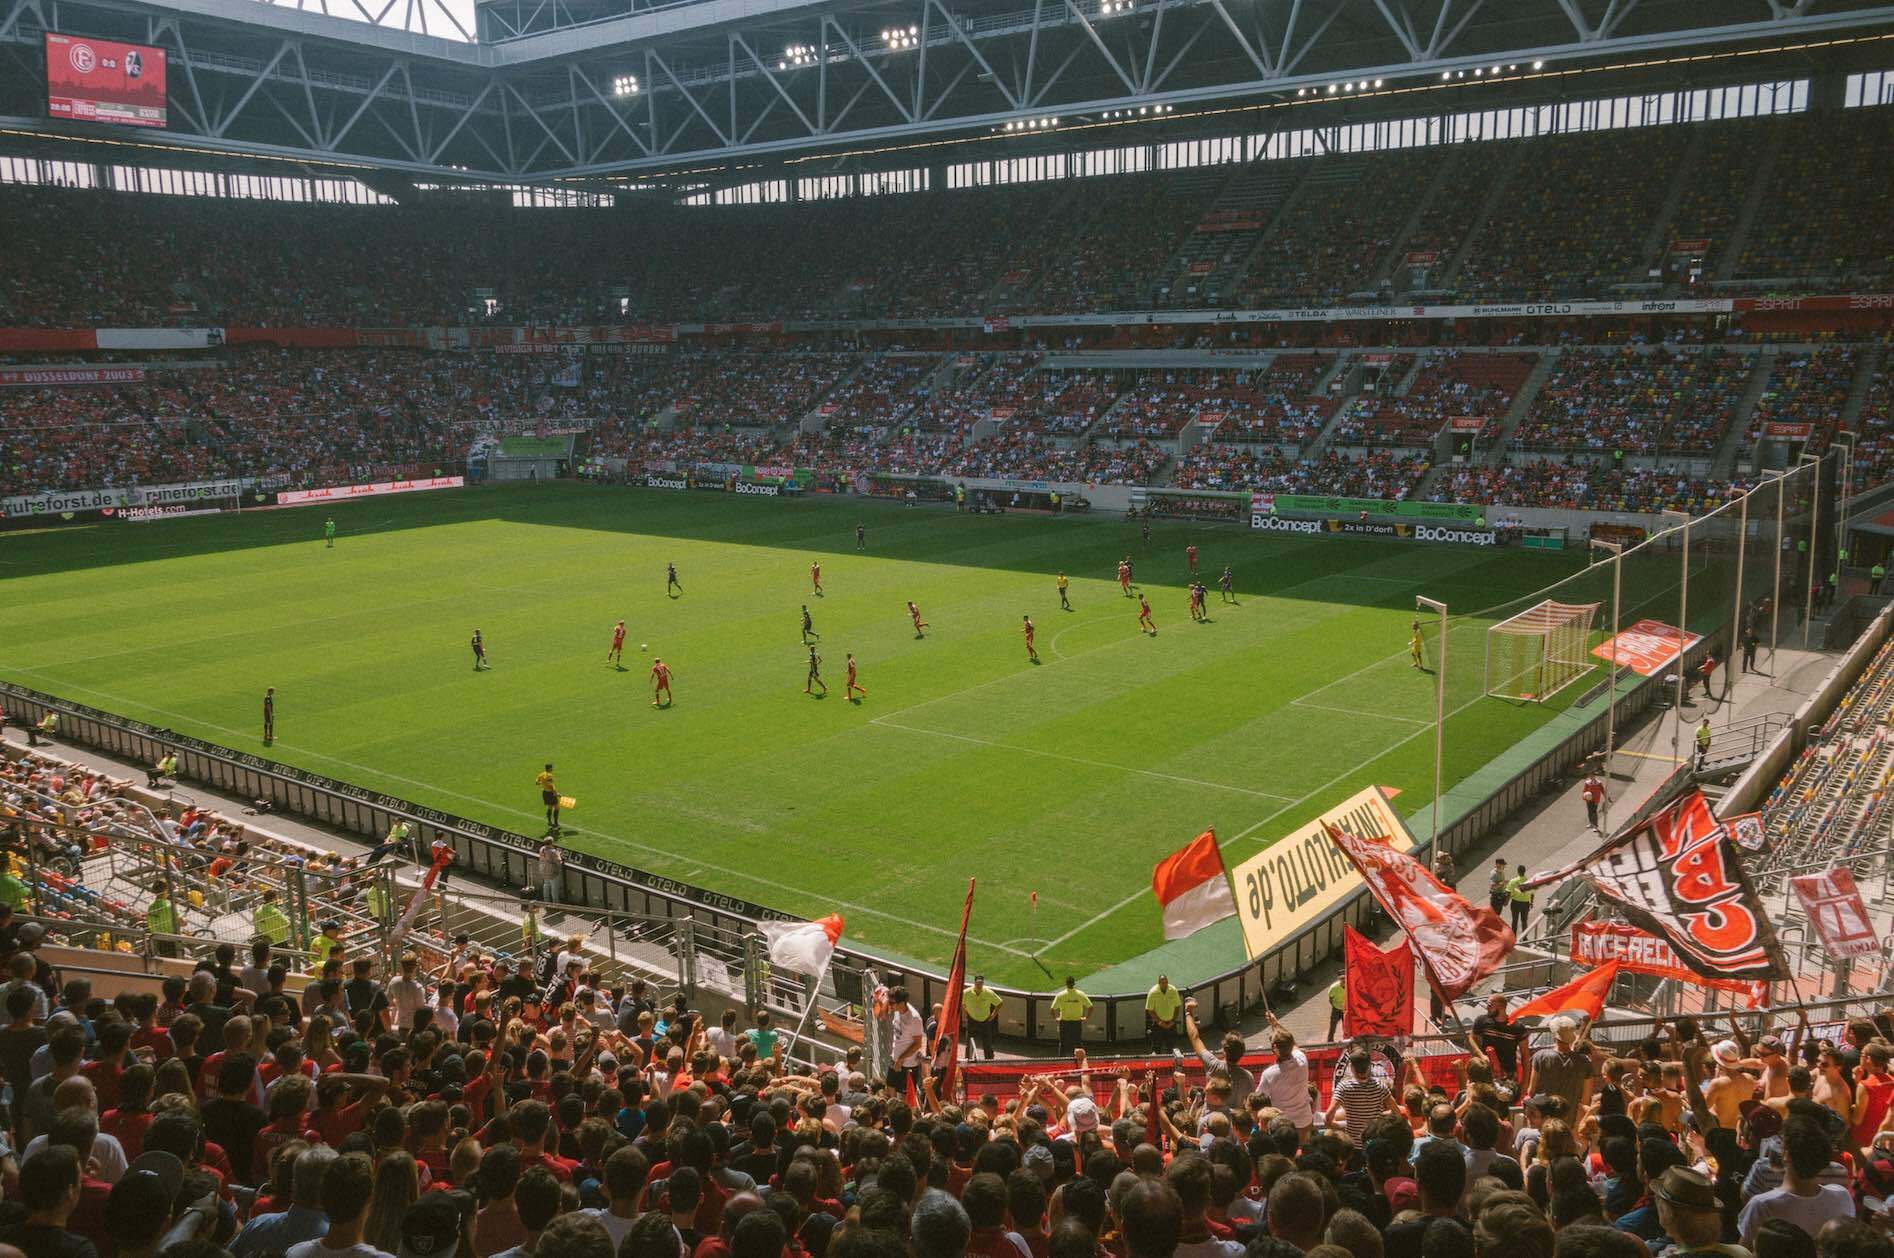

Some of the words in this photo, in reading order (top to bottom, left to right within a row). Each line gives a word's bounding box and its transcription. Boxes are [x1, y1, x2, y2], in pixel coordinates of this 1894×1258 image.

[1754, 296, 1801, 311] ESPRIT
[104, 369, 133, 380] 2003
[1773, 426, 1803, 434] ESPRIT
[647, 477, 688, 490] BoConcept
[736, 481, 779, 497] BoConcept
[118, 504, 186, 519] H-Hotels.com
[1251, 515, 1321, 535] BoConcept
[1344, 523, 1355, 531] 2x
[1365, 523, 1393, 534] D'dorf!
[1415, 525, 1497, 547] BoConcept
